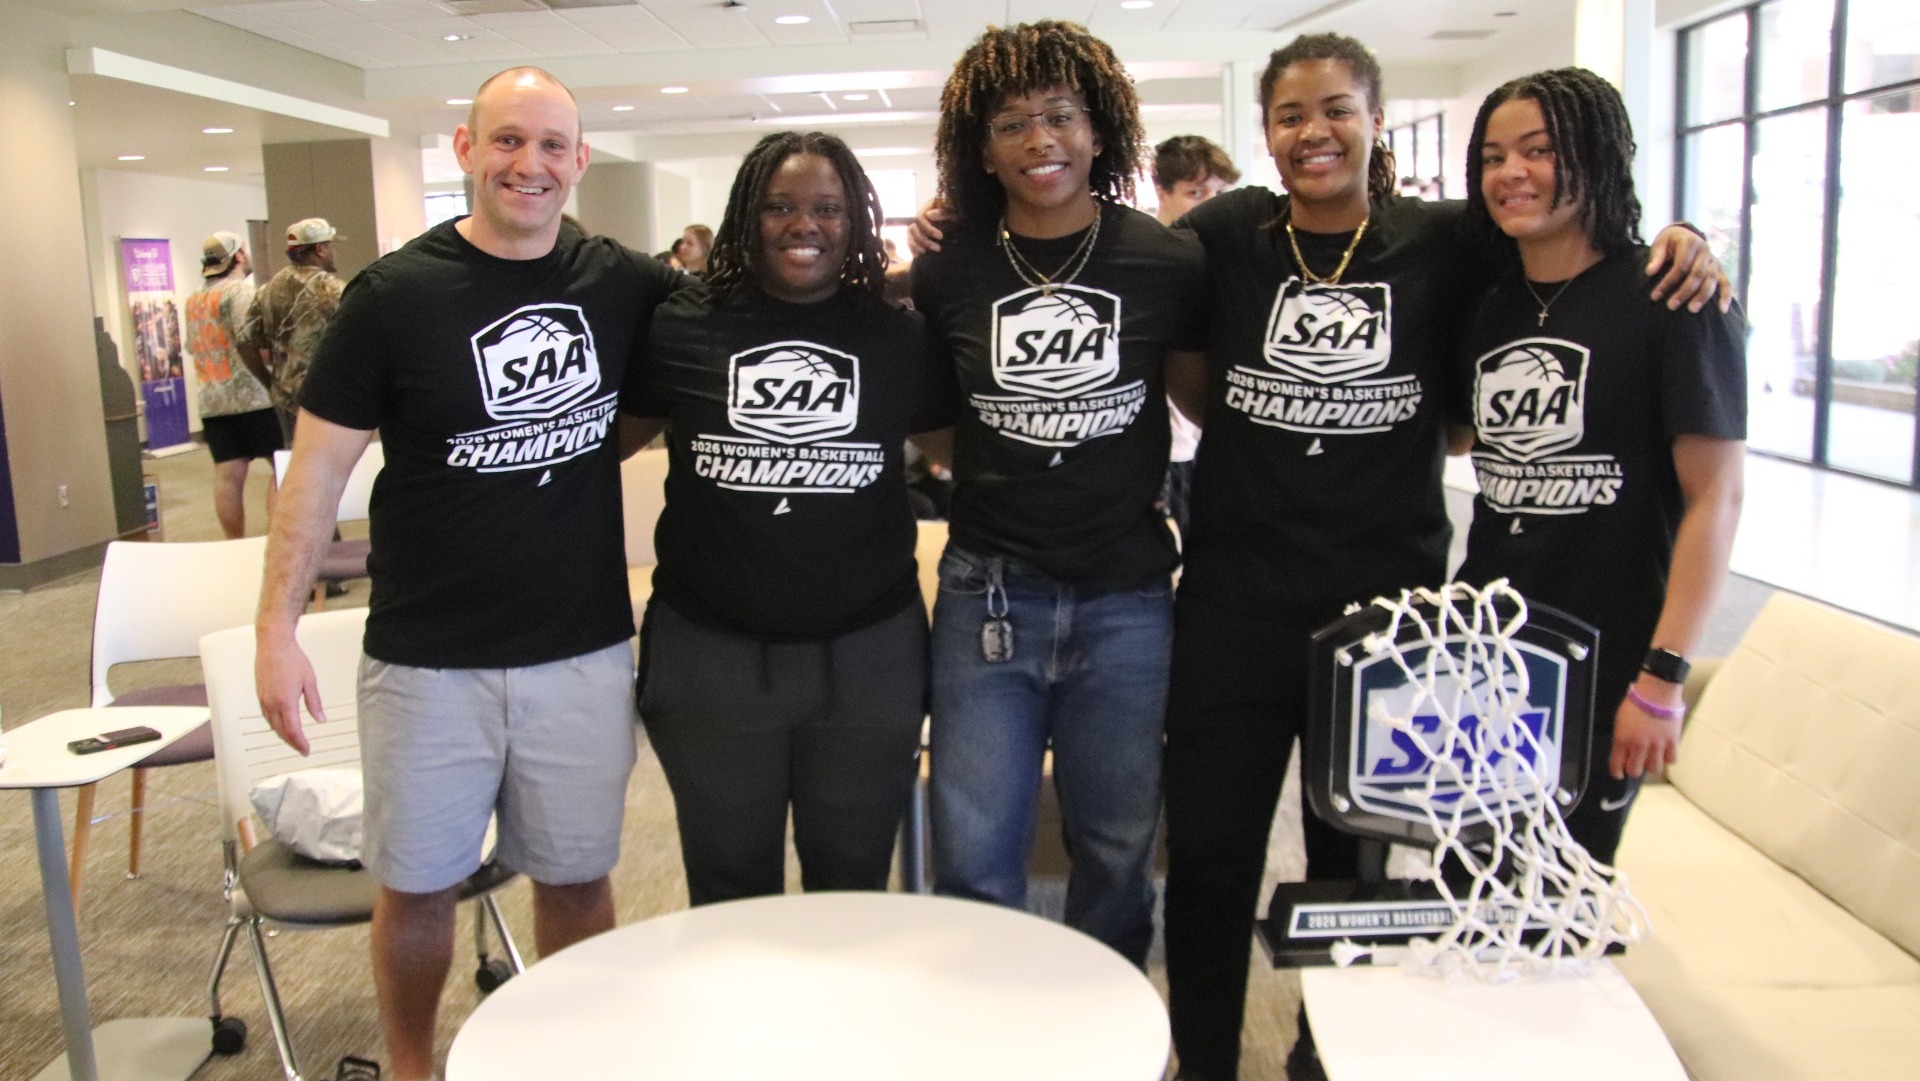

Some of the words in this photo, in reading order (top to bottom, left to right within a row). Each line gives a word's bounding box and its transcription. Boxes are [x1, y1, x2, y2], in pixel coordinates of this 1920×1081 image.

[1006, 325, 1108, 367] SAA
[1279, 313, 1379, 349] SAA
[497, 337, 587, 399] SAA
[741, 378, 848, 413] SAA
[996, 401, 1065, 414] WOMEN'S
[1068, 384, 1146, 412] BASKETBALL
[1226, 370, 1255, 390] 2026
[1256, 380, 1329, 399] WOMEN'S
[1335, 381, 1423, 401] BASKETBALL
[1225, 386, 1423, 427] CHAMPIONS
[1486, 384, 1573, 428] SAA
[486, 420, 556, 441] WOMEN'S
[691, 440, 721, 454] 2026
[722, 444, 796, 459] WOMEN'S
[799, 448, 885, 462] BASKETBALL
[695, 455, 884, 487] CHAMPIONS
[1527, 463, 1624, 477] BASKETBALL
[1371, 712, 1546, 776] SAA
[1338, 912, 1391, 928] WOMEN'S
